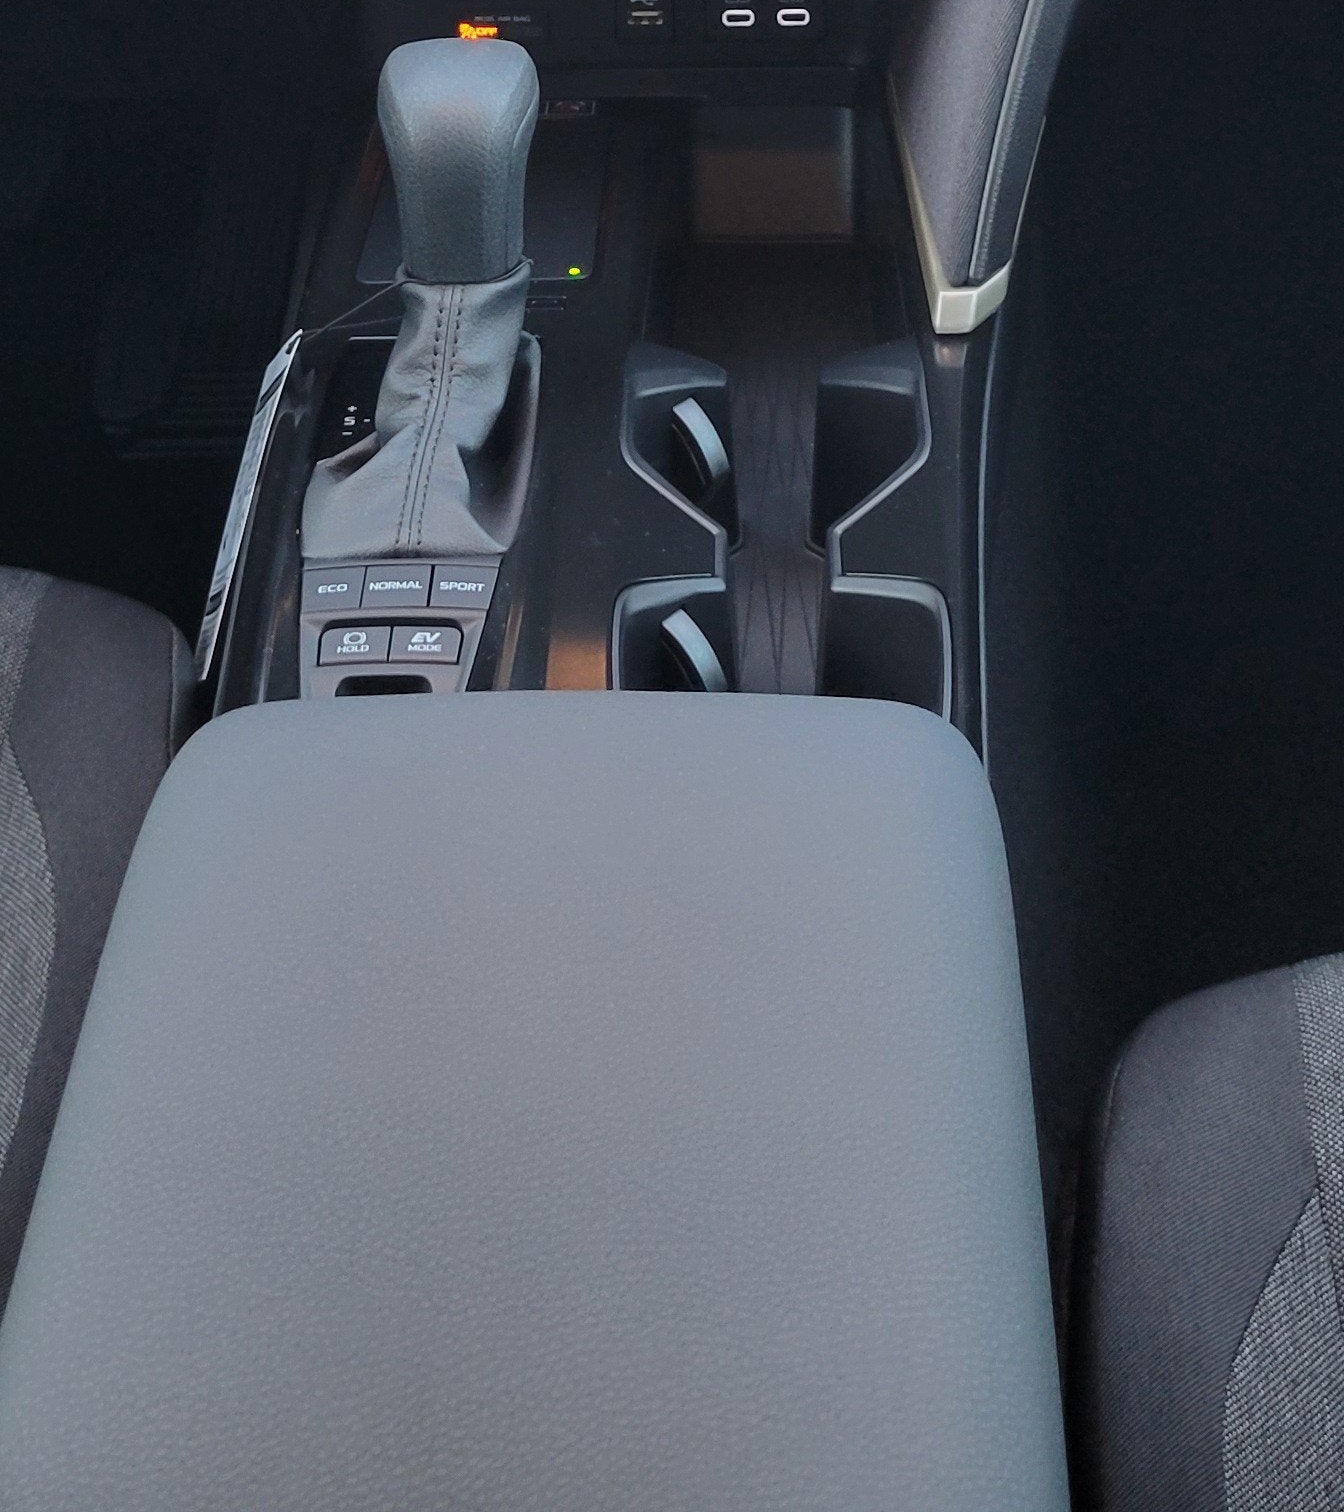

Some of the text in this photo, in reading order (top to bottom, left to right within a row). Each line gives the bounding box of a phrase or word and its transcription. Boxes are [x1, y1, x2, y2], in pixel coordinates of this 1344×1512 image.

[343, 416, 356, 426] S
[318, 580, 486, 594] ECO NORMAL SPORT
[410, 631, 442, 644] EV
[337, 644, 370, 654] HOLD
[407, 643, 443, 653] MODE
